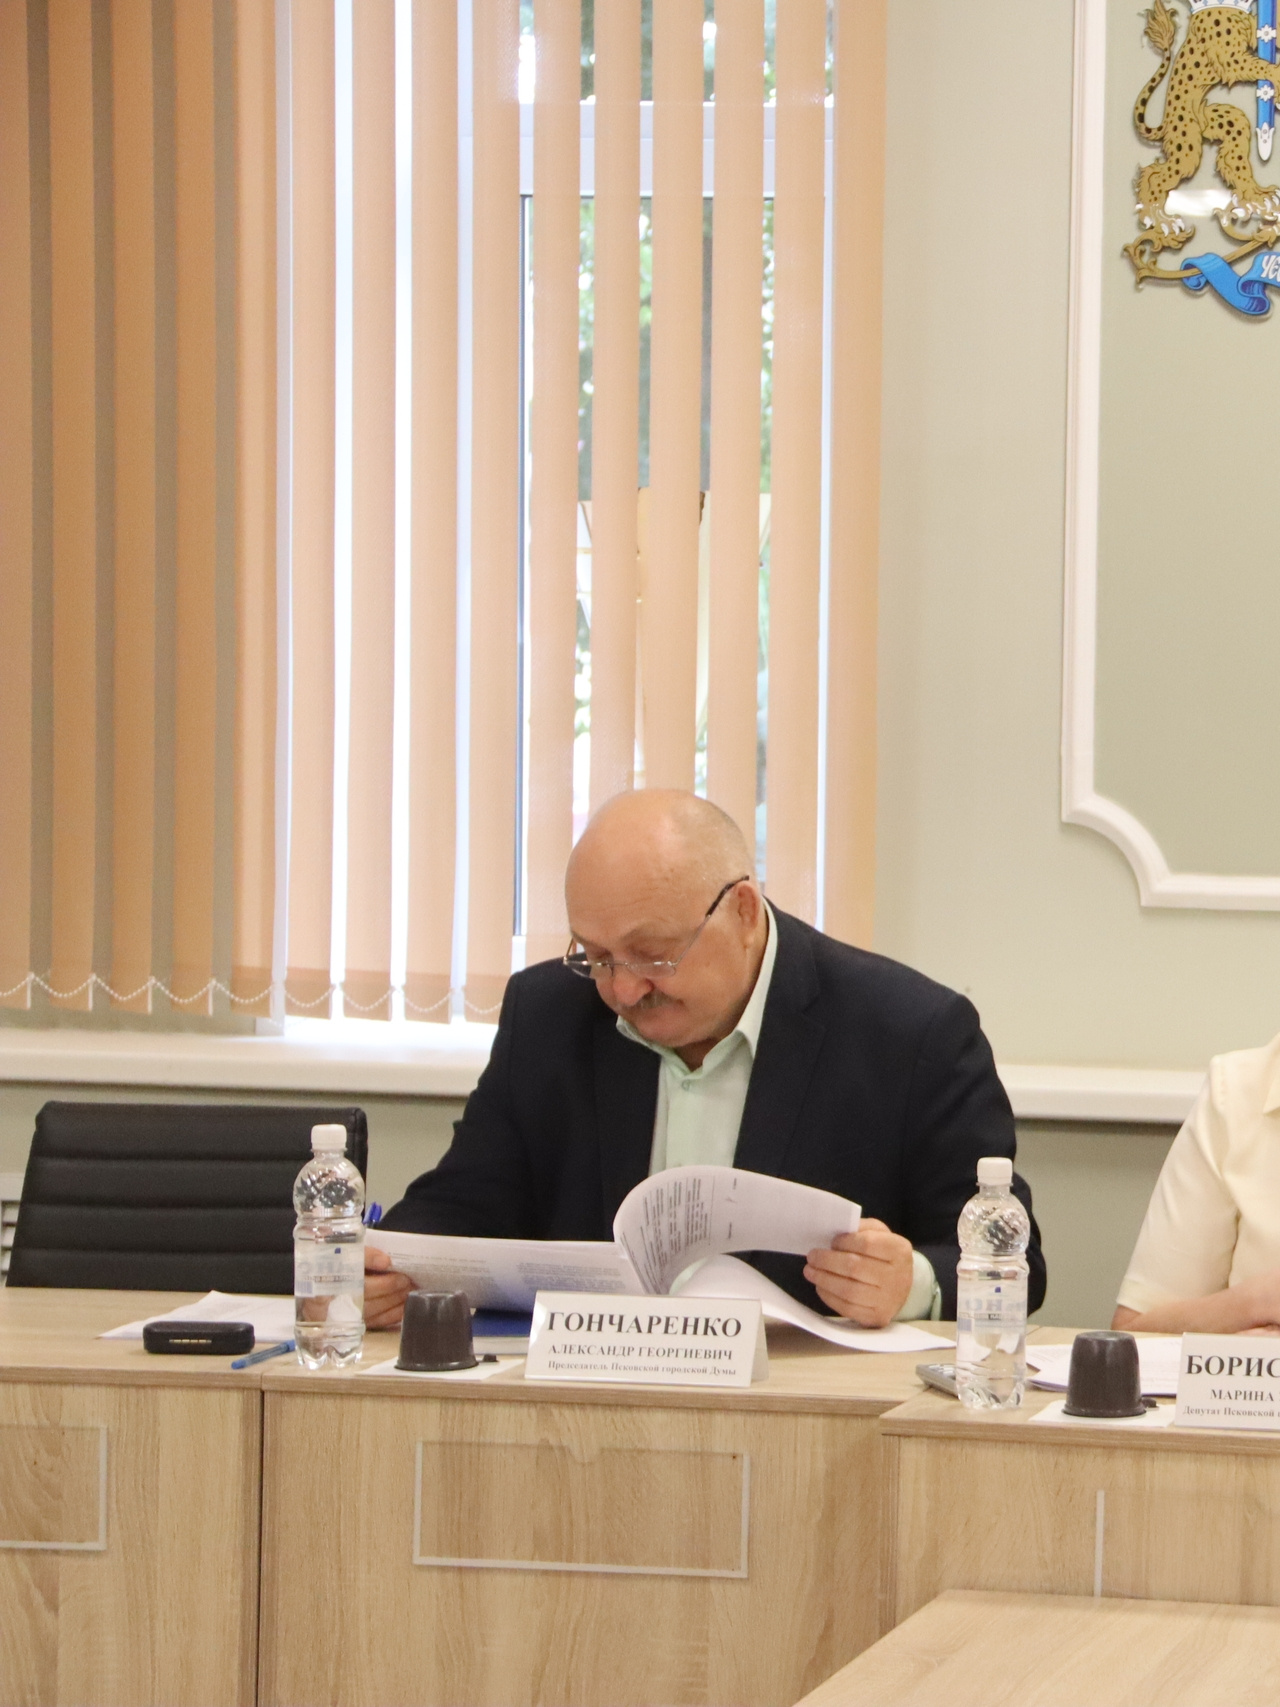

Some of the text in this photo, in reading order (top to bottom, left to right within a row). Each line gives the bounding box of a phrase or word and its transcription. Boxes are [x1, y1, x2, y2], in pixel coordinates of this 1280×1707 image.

[547, 1311, 742, 1337] ГОНЧАРЕНКО
[548, 1344, 733, 1361] АЛЕКСАНДР ГЕОРГИЕВИЧ
[548, 1360, 736, 1376] Председатель Псковской городской Думы
[1210, 1389, 1274, 1402] МАРИНА
[1183, 1406, 1221, 1416] Депутат
[1224, 1406, 1275, 1417] Псковской
